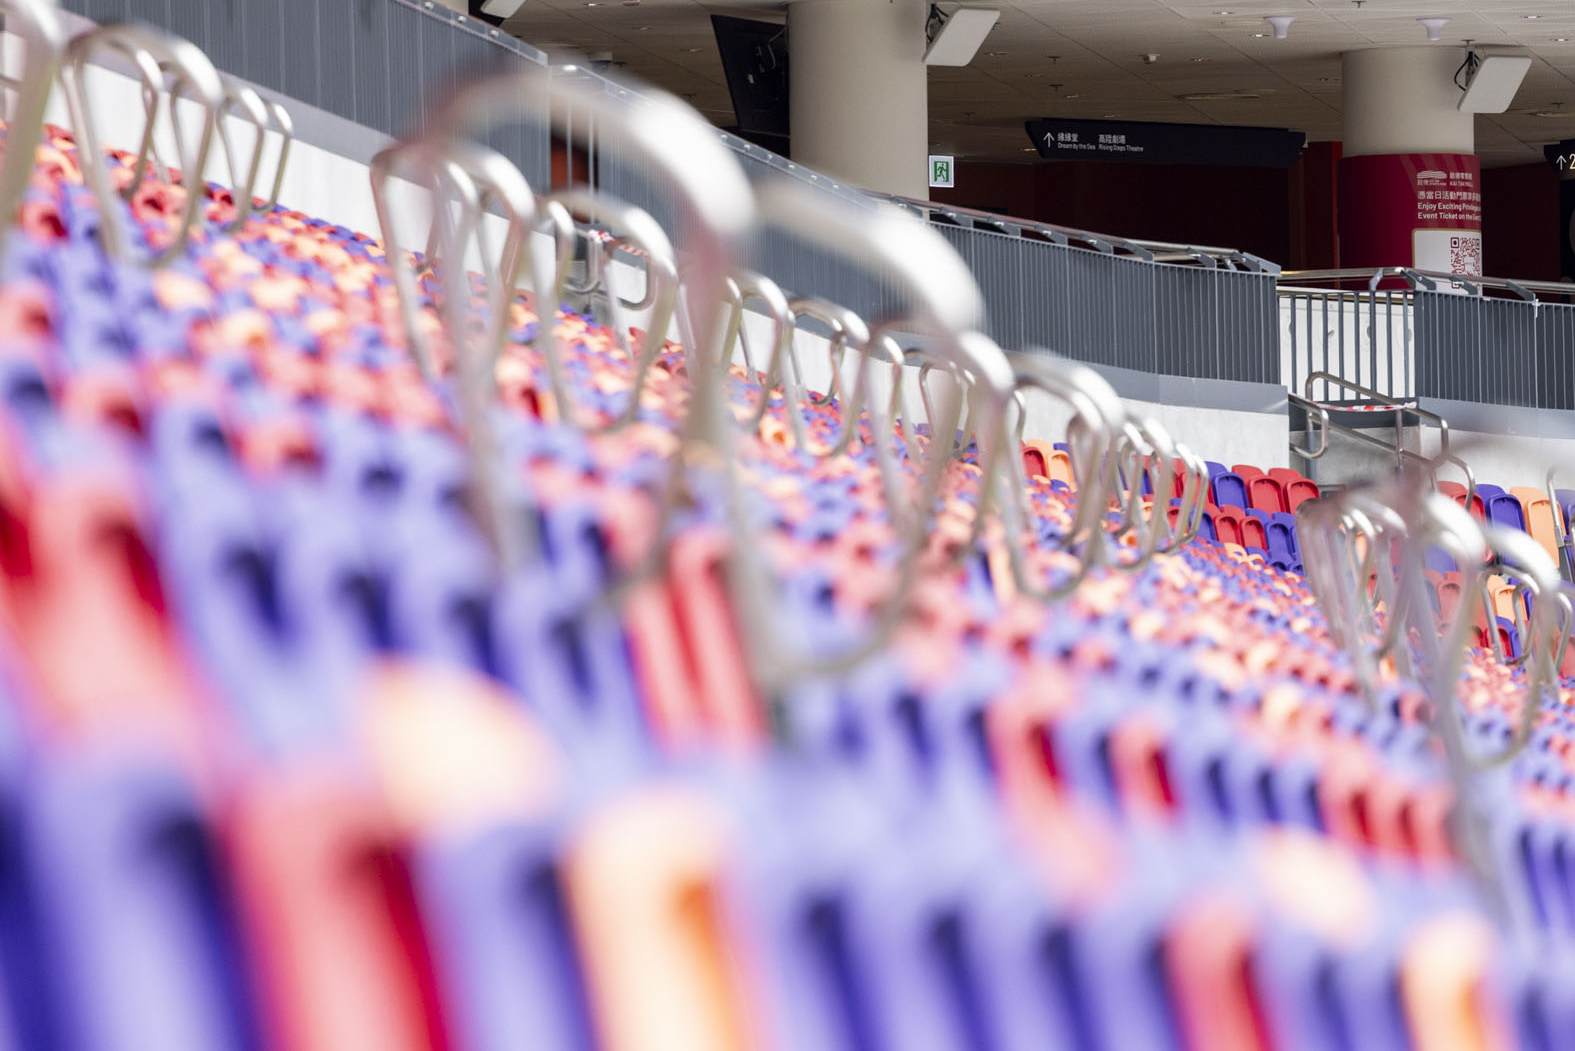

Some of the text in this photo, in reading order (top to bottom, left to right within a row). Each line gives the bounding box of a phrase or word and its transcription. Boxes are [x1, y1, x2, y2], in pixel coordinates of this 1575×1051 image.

[1417, 202, 1437, 211] Enjoy
[1417, 212, 1438, 220] Event
[1439, 212, 1458, 220] Ticket
